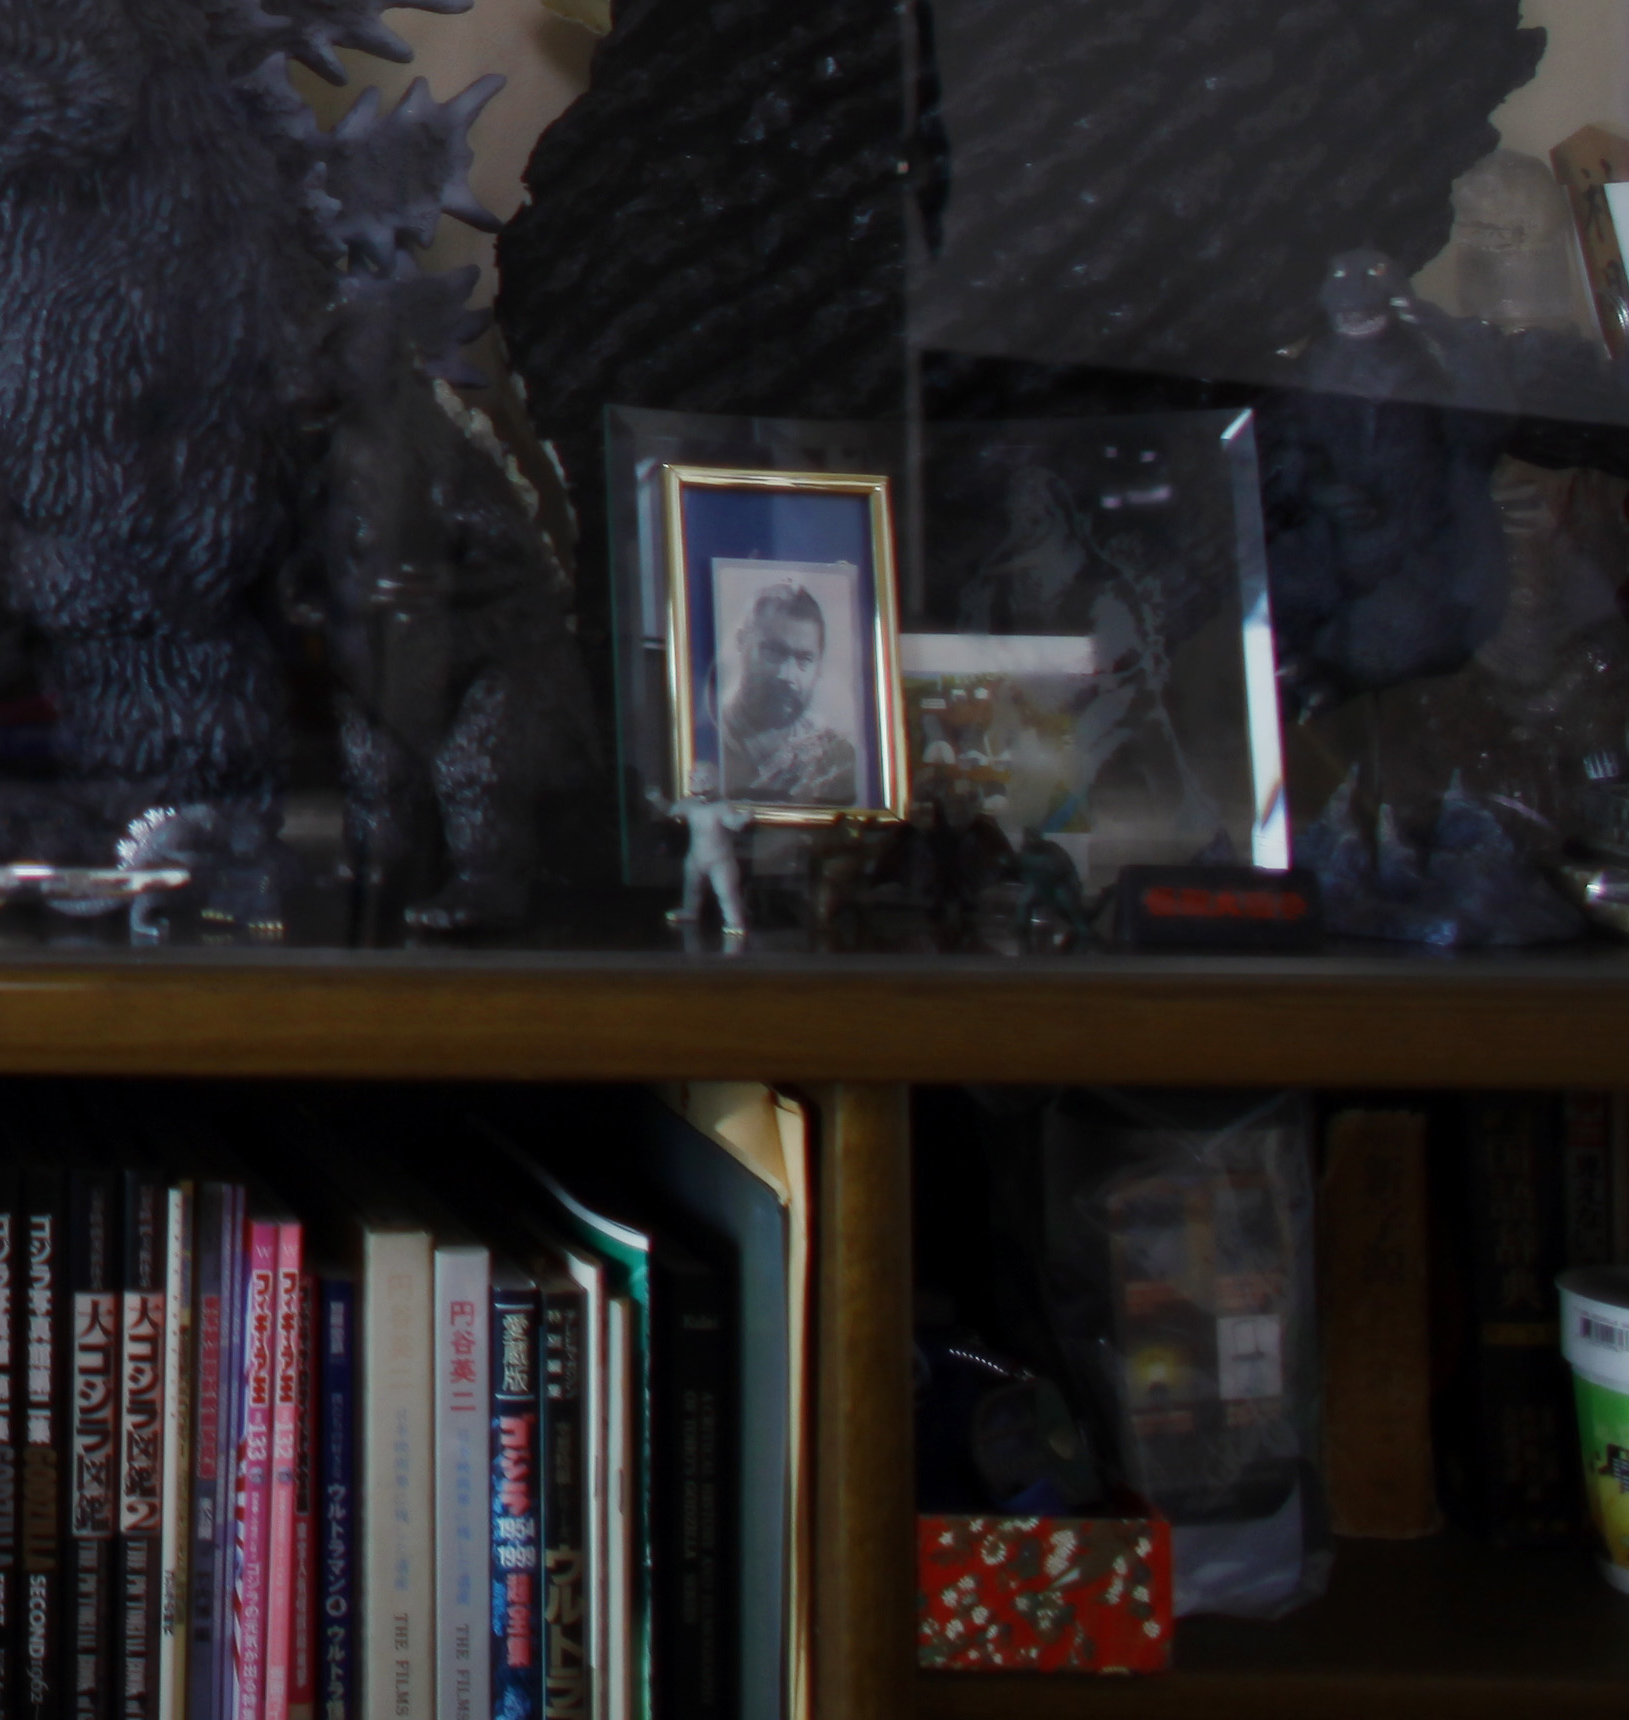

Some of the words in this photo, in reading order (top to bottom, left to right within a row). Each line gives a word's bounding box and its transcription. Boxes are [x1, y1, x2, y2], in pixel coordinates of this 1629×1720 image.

[450, 1301, 477, 1412] 円谷英二
[75, 1298, 115, 1531] 大ゴジラ図鑑
[22, 1445, 58, 1570] GODZILLA
[496, 1517, 536, 1540] 1954
[496, 1545, 536, 1569] 1999
[28, 1574, 47, 1659] SECOND
[393, 1613, 410, 1652] THE
[455, 1624, 471, 1661] THE
[394, 1659, 411, 1717] FILMS
